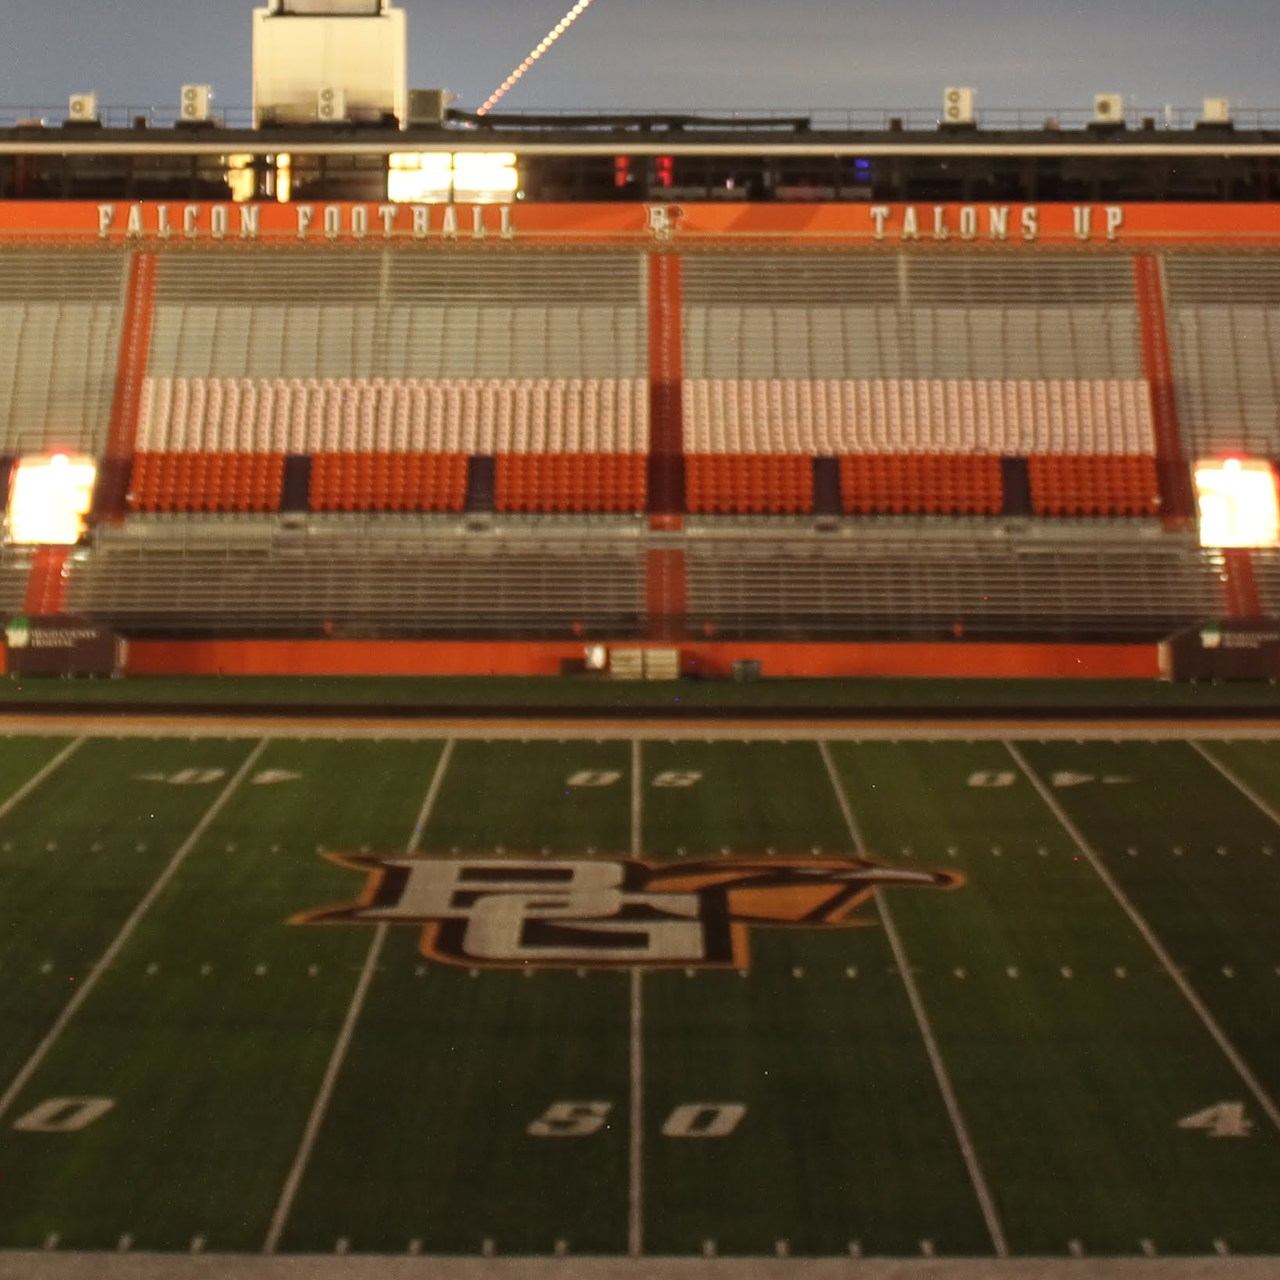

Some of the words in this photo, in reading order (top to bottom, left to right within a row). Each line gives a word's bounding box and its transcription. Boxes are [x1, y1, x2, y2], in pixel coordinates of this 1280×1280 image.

[97, 203, 259, 239] FALCON
[296, 203, 517, 239] FOOTBALL
[870, 205, 1039, 240] TALONS
[1073, 205, 1123, 240] UP
